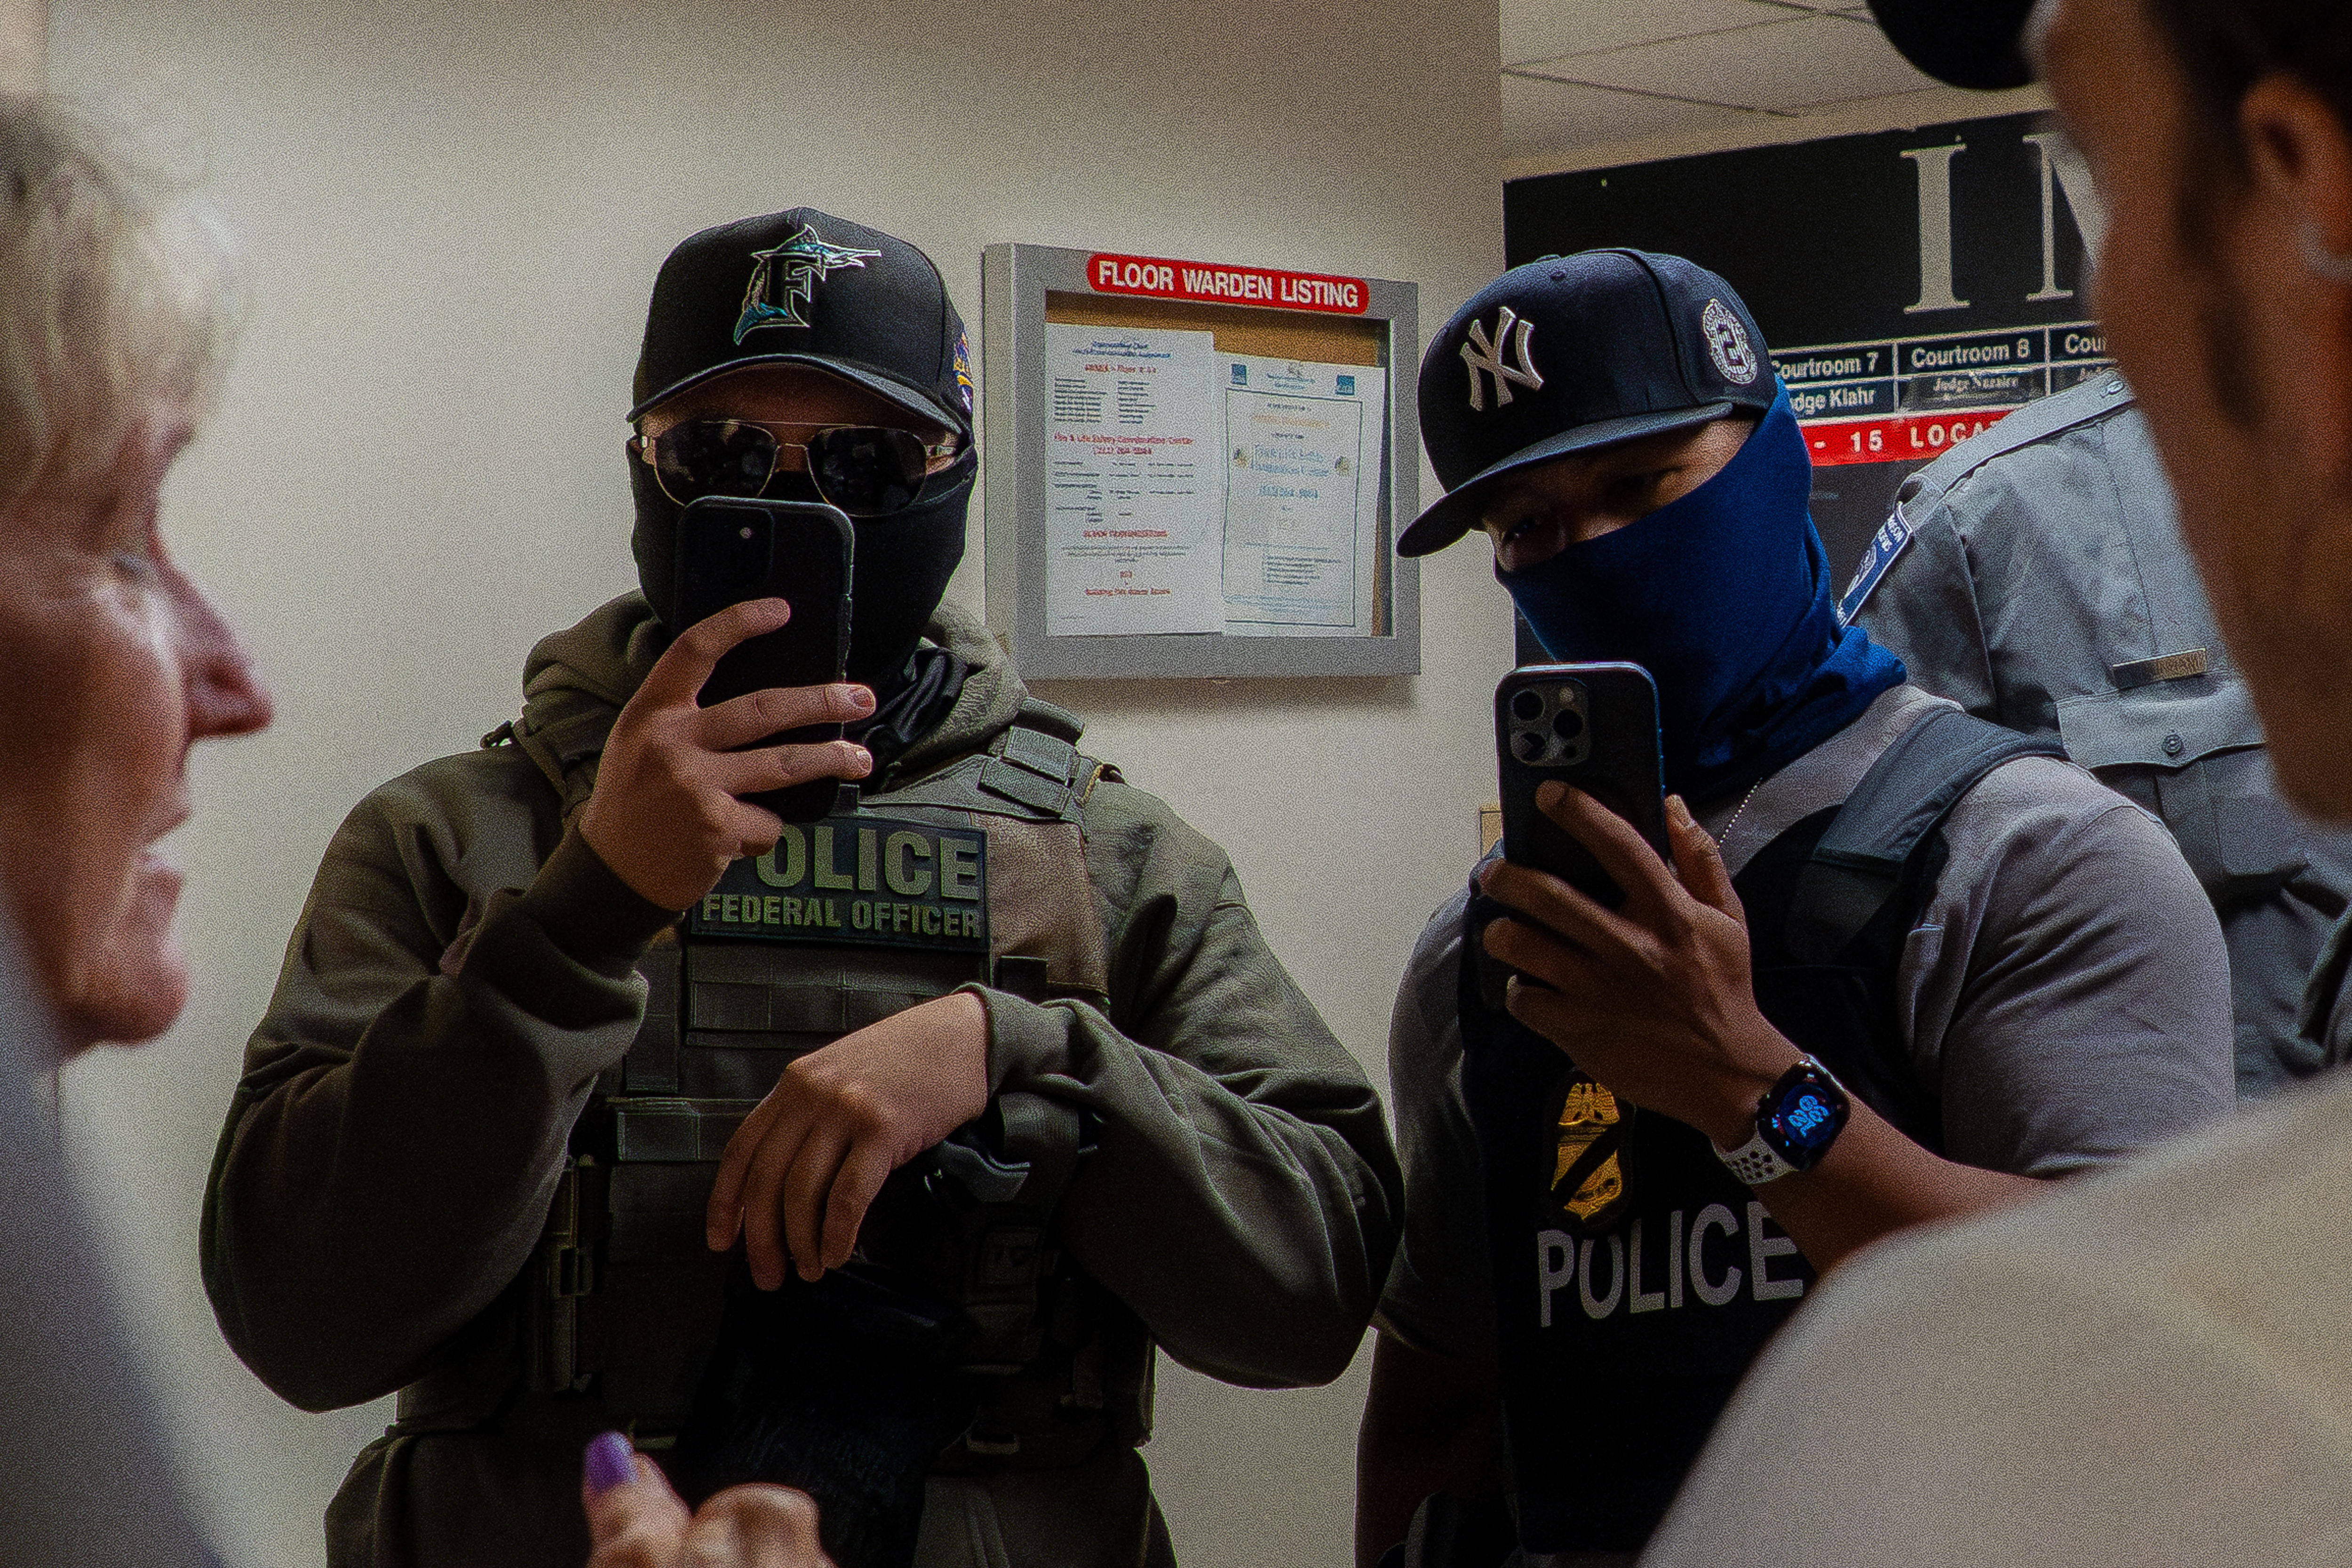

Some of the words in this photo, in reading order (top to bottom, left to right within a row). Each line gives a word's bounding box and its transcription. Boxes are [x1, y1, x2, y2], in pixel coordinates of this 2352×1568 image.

[1098, 260, 1175, 291] FLOOR
[1182, 269, 1273, 300] WARDEN
[1280, 278, 1359, 308] LISTING
[1459, 306, 1545, 412] NY
[1867, 351, 1879, 373] 7
[1911, 345, 2010, 368] Courtroom
[2017, 339, 2030, 358] 8
[1790, 392, 1827, 415] dge
[1829, 387, 1875, 408] Klahr
[1850, 429, 1883, 453] 15
[756, 823, 979, 900] OLICE
[702, 894, 842, 928] FEDERAL
[851, 899, 981, 939] OFFICER
[1537, 1200, 1804, 1329] POLICE
